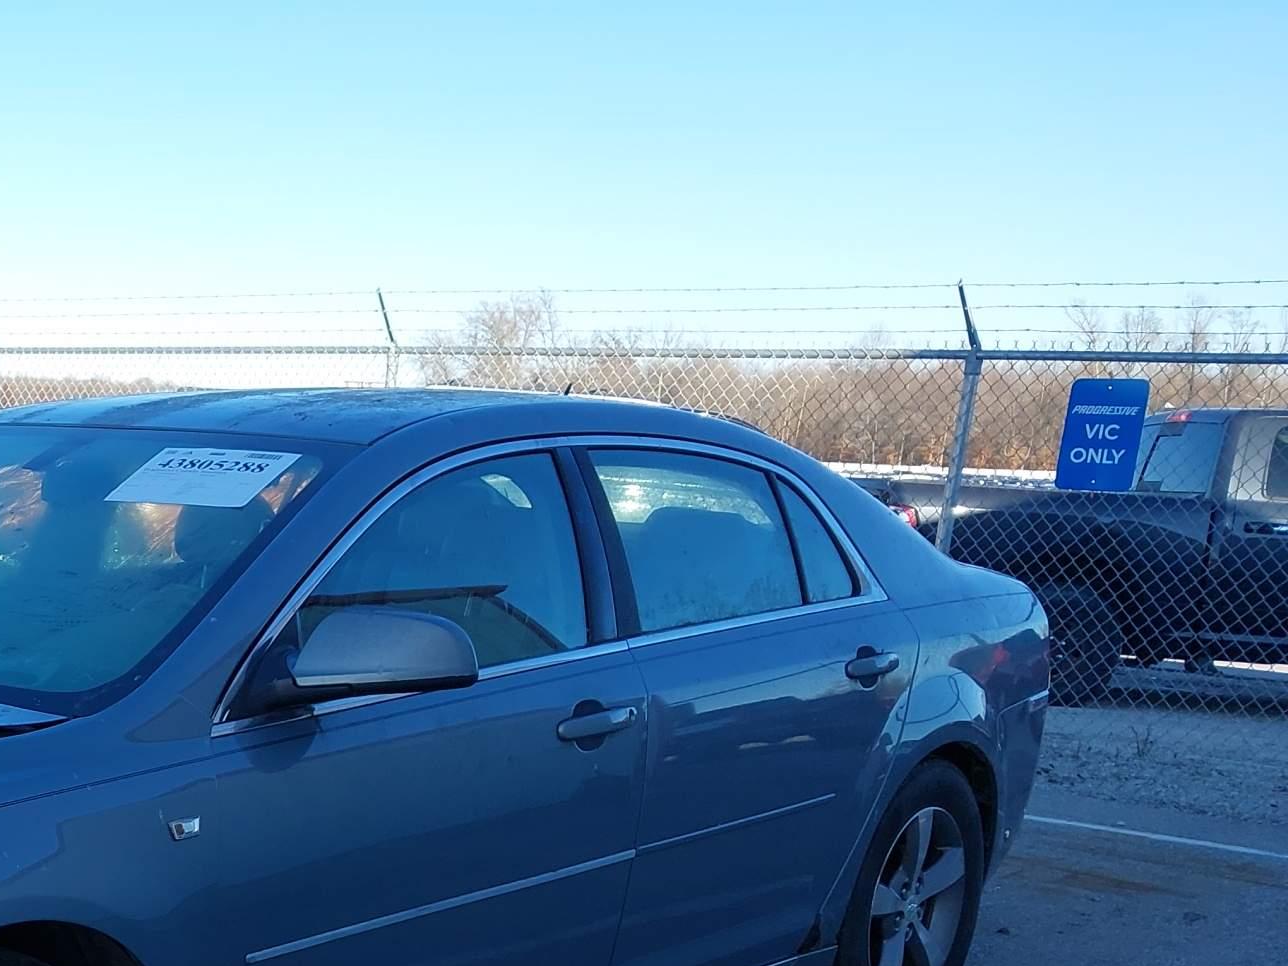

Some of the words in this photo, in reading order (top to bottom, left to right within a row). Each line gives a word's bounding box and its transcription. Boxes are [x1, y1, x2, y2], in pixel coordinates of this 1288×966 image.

[1072, 404, 1142, 416] PROGRESSIVE
[1085, 423, 1121, 441] VIC
[1069, 447, 1126, 465] ONLY
[157, 457, 270, 474] 43805288
